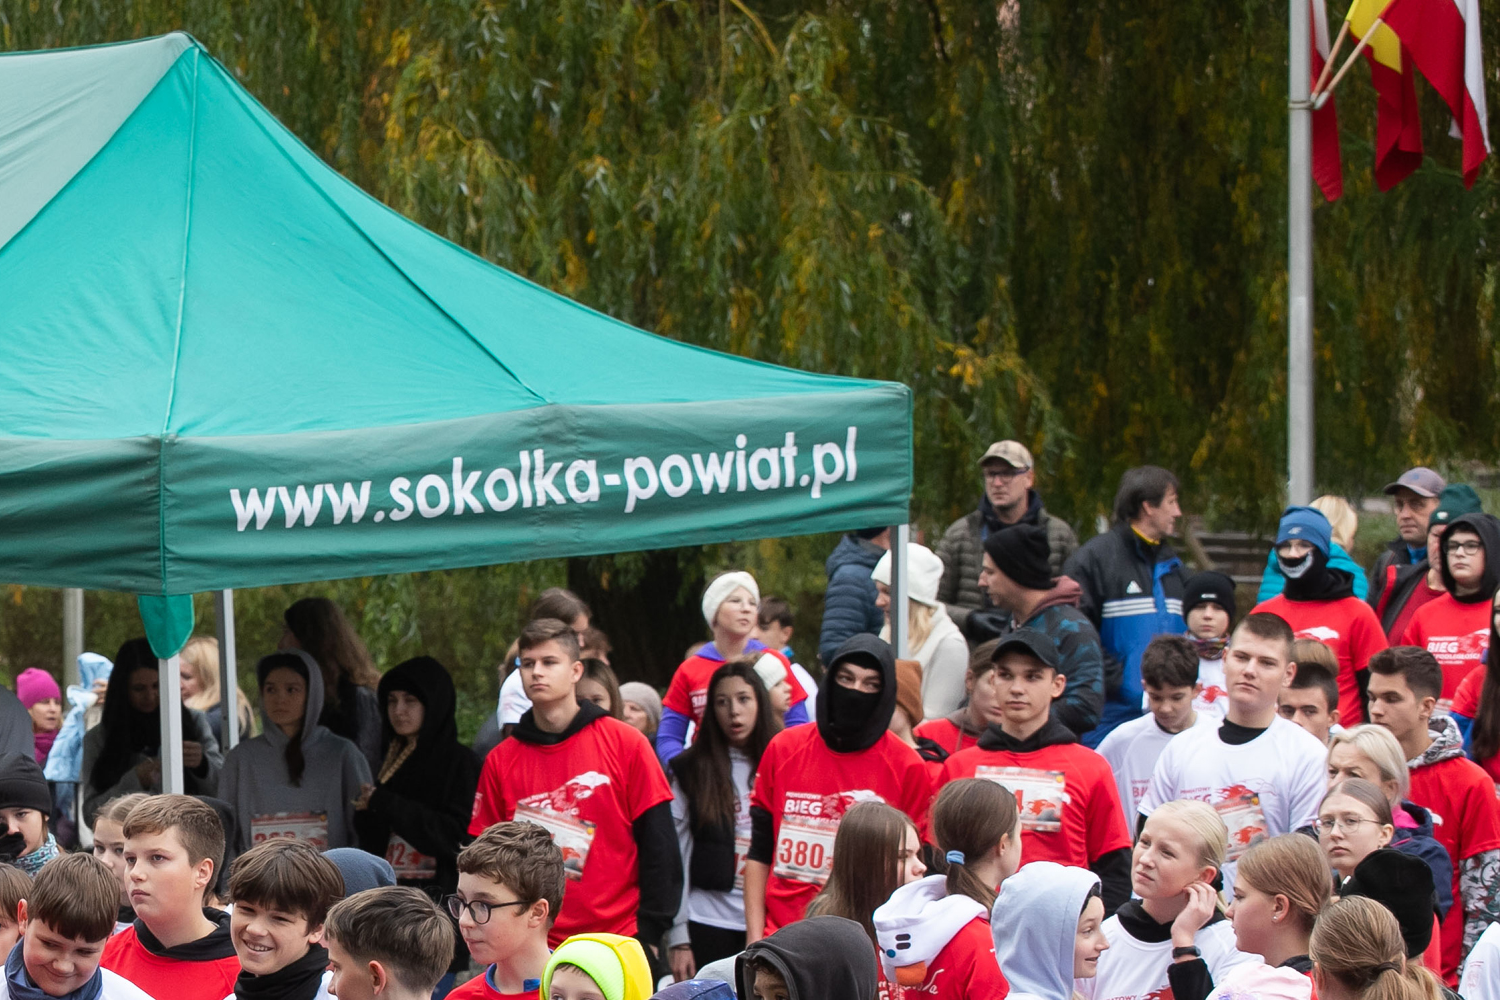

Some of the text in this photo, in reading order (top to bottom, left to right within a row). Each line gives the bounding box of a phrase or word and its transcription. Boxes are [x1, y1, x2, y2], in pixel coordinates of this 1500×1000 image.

[229, 426, 858, 532] www.sokolka-powiat.pl
[1427, 642, 1459, 653] BIEG
[784, 799, 823, 815] BIEG
[779, 838, 824, 869] 380
